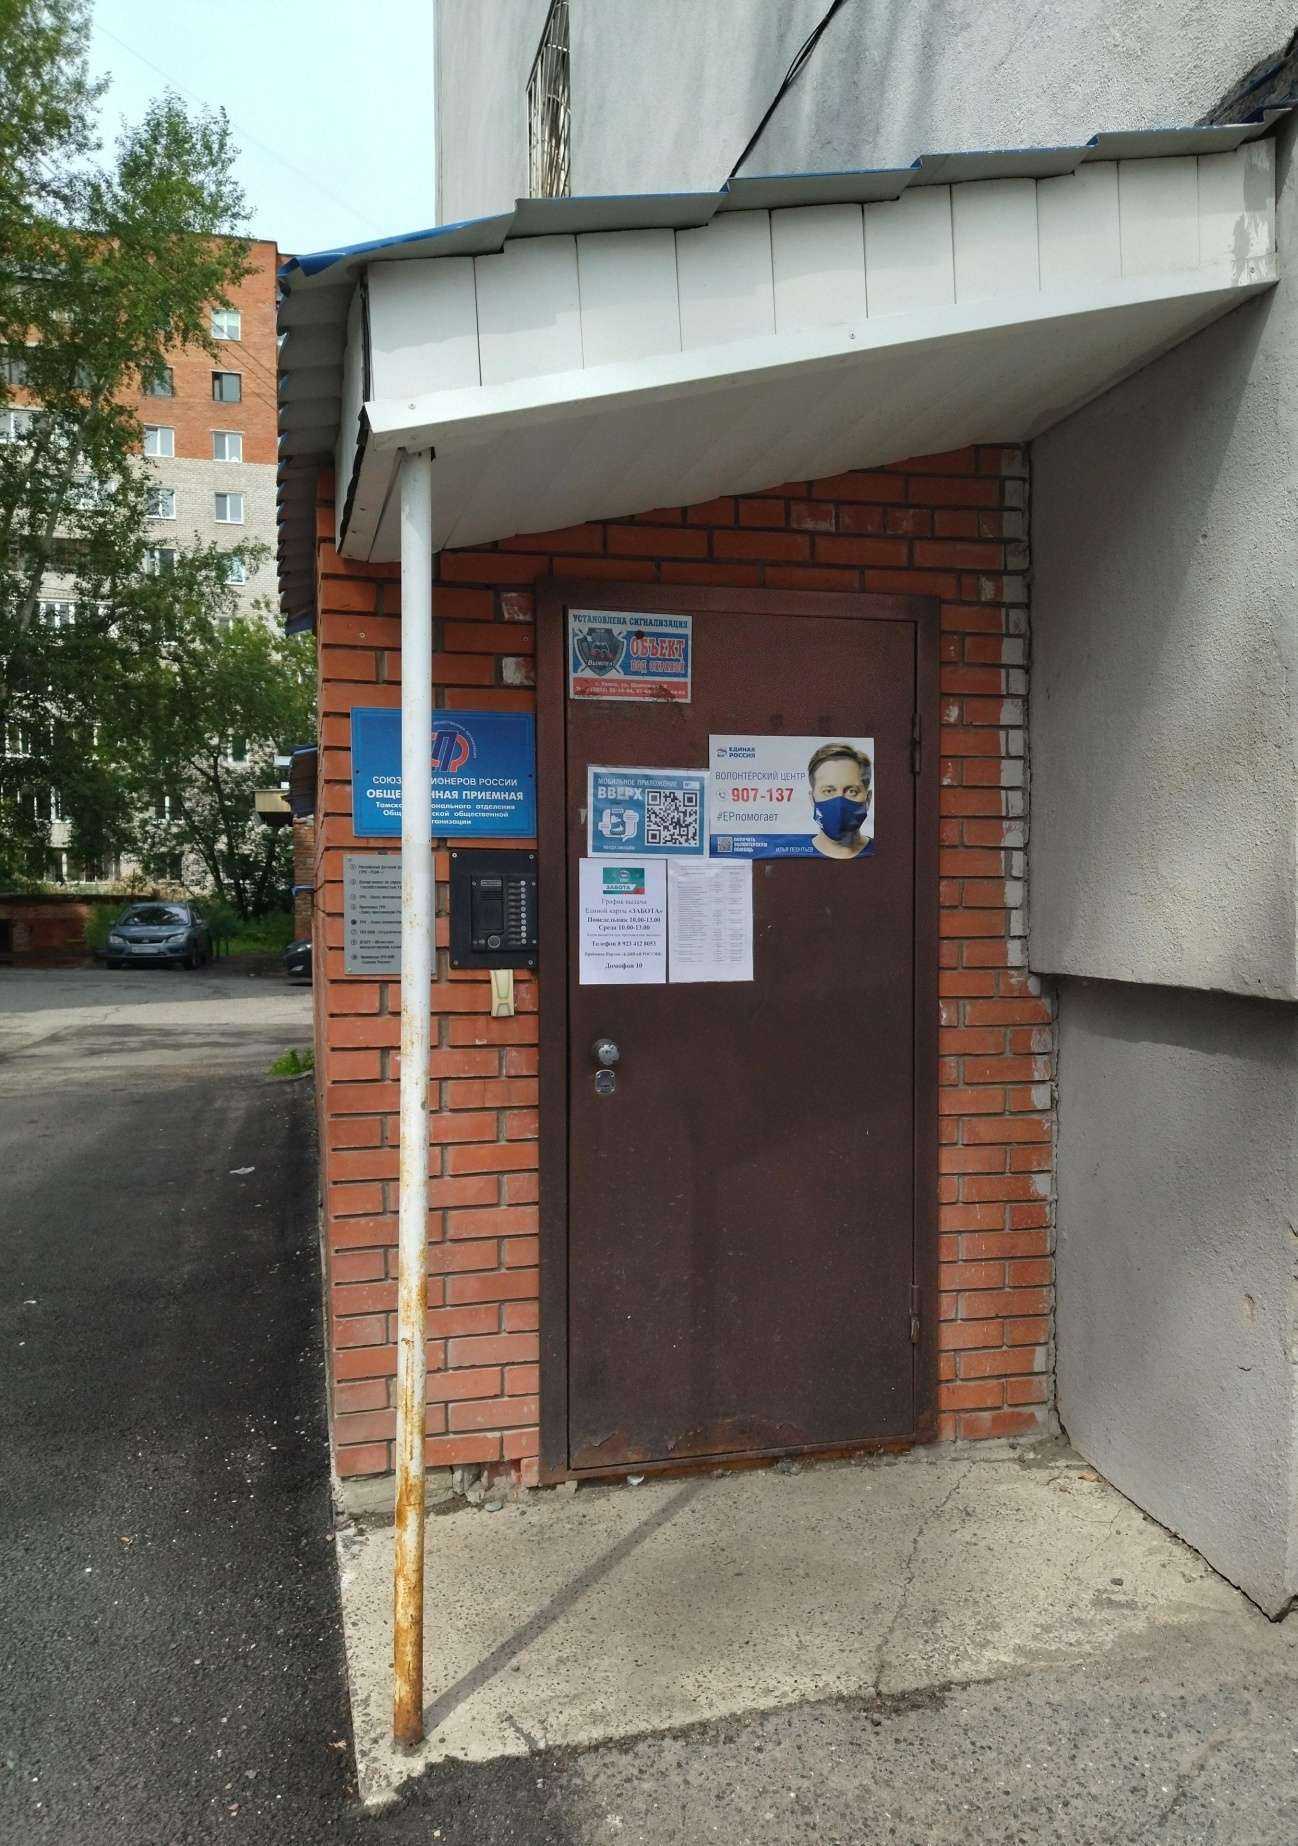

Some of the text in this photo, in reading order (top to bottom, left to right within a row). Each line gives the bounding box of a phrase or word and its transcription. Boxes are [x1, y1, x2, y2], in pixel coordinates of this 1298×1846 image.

[573, 614, 627, 625] УСТАНОВЛЕНА
[630, 636, 685, 658] ОБЪЕКТ
[372, 776, 518, 787] СОЮЗ ИОНЕРОВ РОССИИ
[781, 772, 806, 782] ЦЕНТР
[462, 790, 524, 801] ПРИЕМНАЯ
[731, 787, 794, 802] 907-137
[716, 811, 779, 822] #ЕРпомогает
